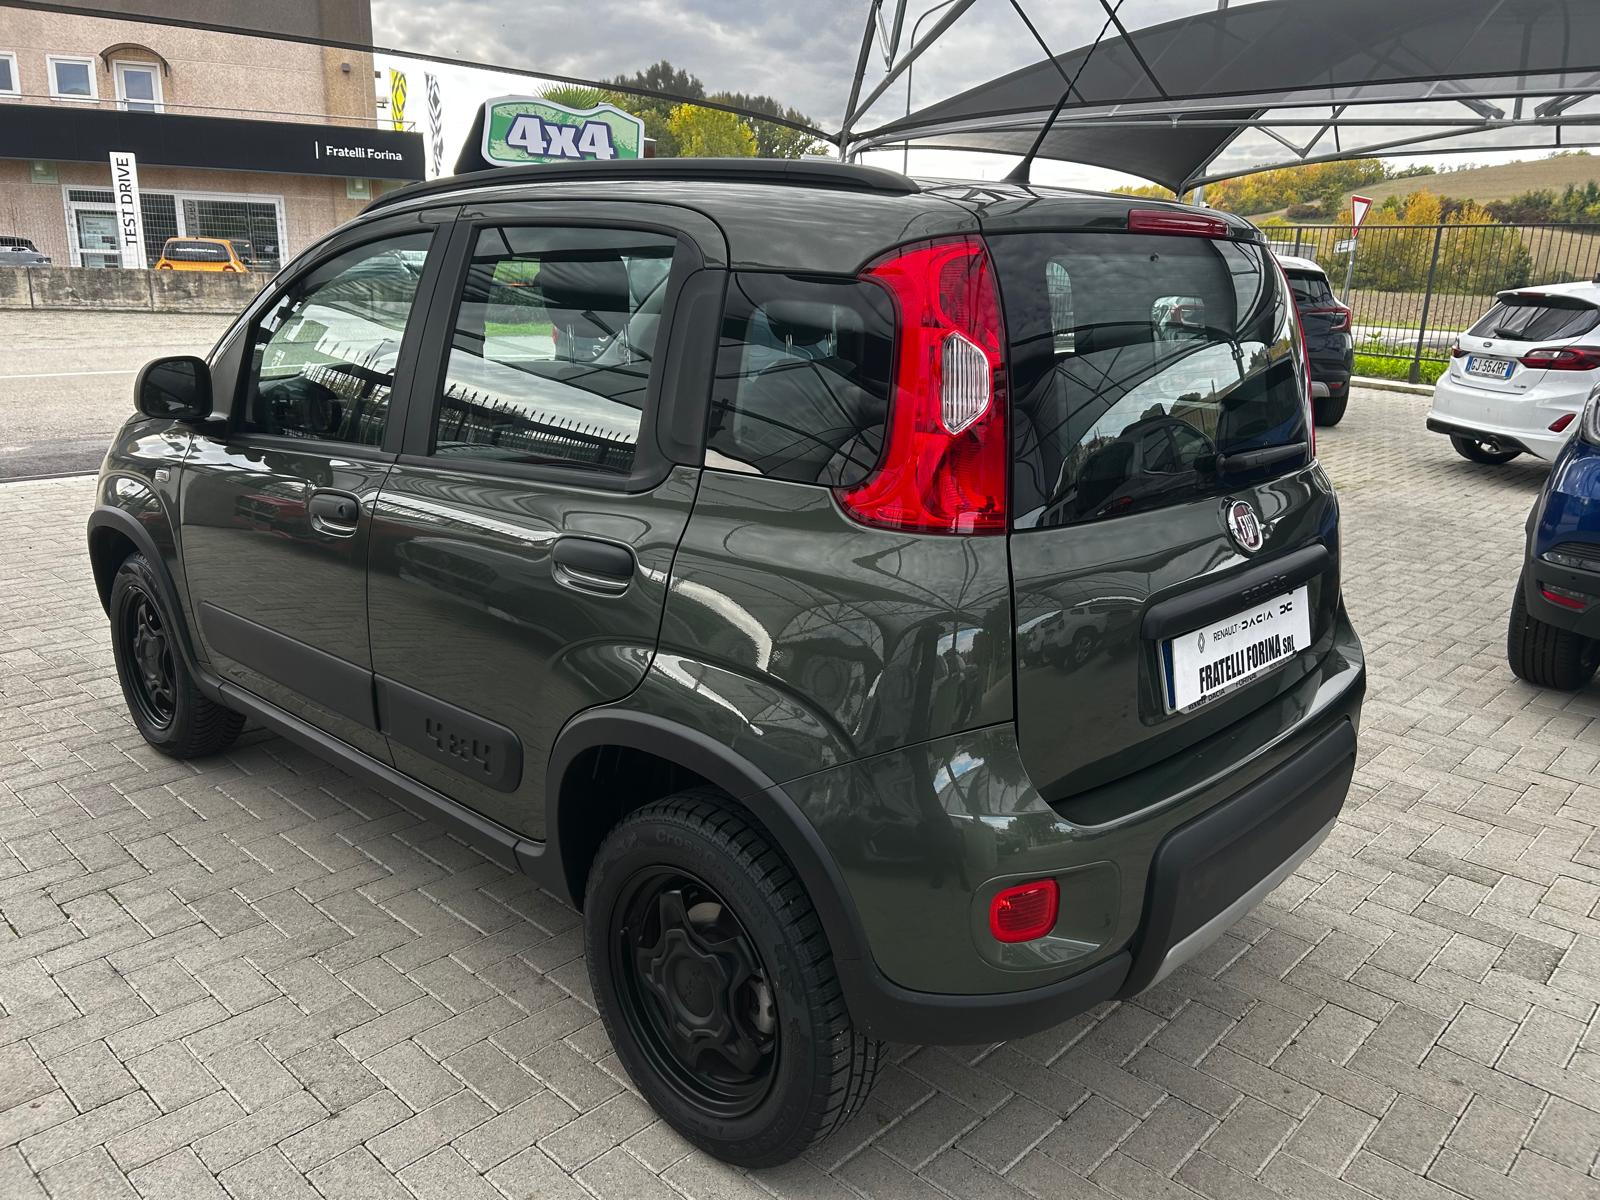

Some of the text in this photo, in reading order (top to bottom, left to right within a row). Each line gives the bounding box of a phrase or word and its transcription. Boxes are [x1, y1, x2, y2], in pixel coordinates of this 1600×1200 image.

[325, 145, 403, 161] Fratelli Forina
[506, 115, 616, 160] 4x4
[116, 157, 138, 247] TEST DRIVE
[1213, 623, 1239, 642] RENAULT
[1241, 611, 1273, 630] DACIA
[1199, 634, 1295, 694] FRATELLI FORINA SRL
[425, 718, 493, 776] 4x4
